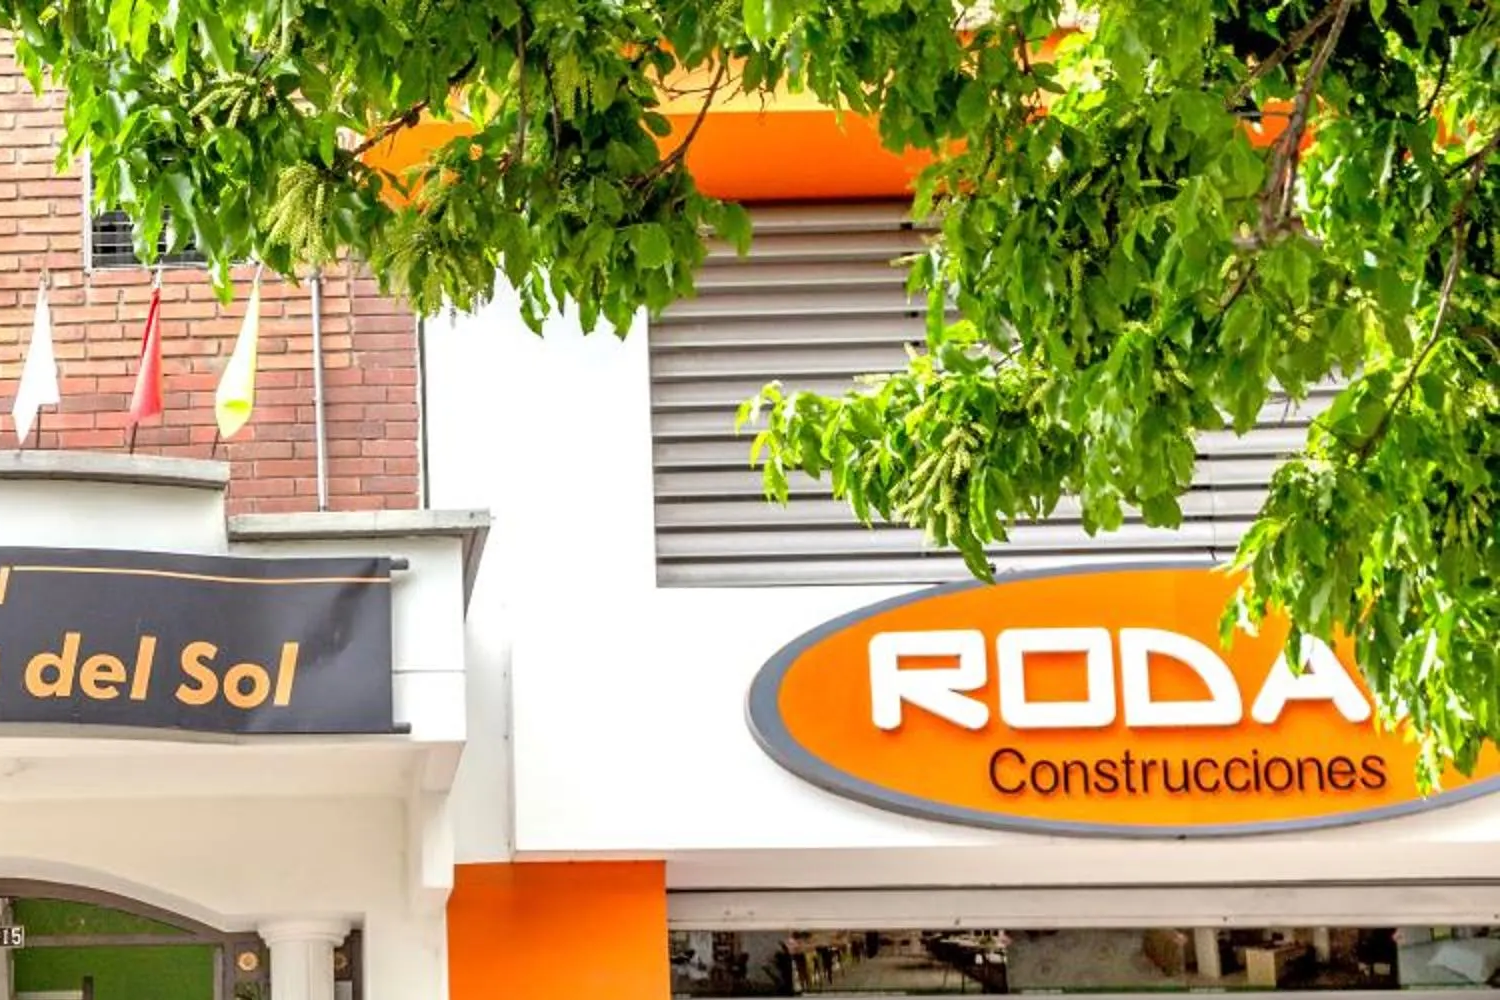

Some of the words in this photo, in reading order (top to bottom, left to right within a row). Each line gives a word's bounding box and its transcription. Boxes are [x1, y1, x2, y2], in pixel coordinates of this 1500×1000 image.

[23, 631, 157, 703] del
[175, 640, 301, 709] Sol
[869, 628, 1408, 730] RODA
[988, 746, 1388, 797] Construcciones
